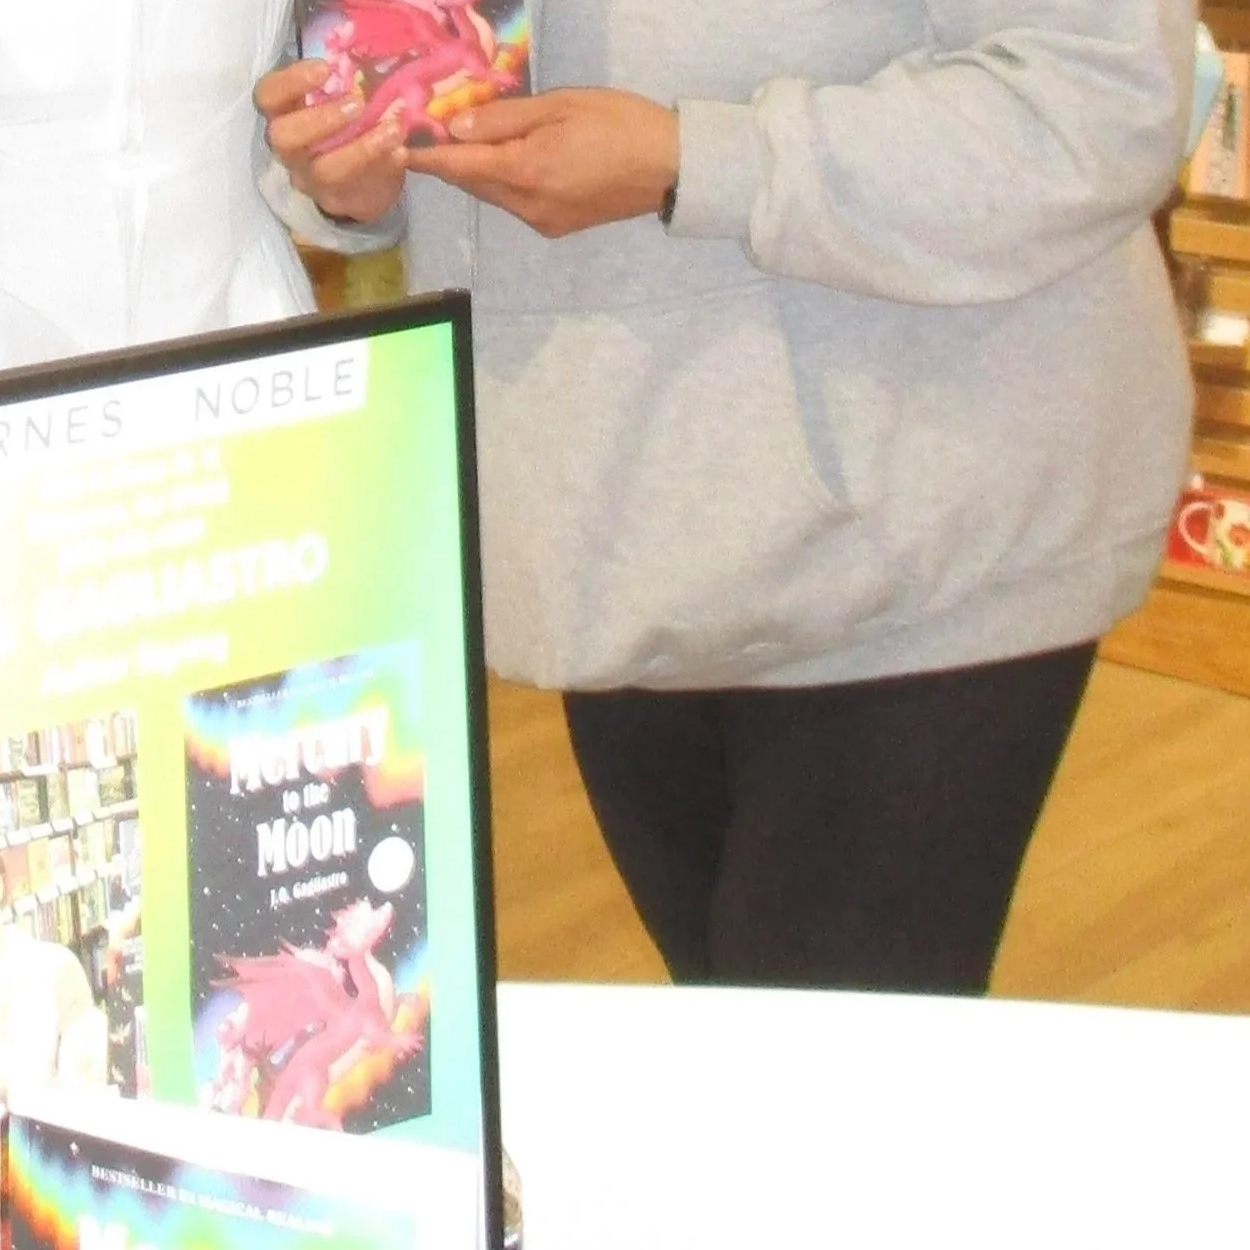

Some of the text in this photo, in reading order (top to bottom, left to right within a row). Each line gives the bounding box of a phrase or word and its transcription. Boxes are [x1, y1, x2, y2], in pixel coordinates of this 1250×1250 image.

[194, 357, 355, 423] NOBLE
[226, 705, 390, 795] Mercury
[281, 781, 331, 814] to the
[255, 806, 358, 878] Moon
[91, 1163, 178, 1201] BESTSELLER
[197, 1192, 264, 1219] MAGICAL
